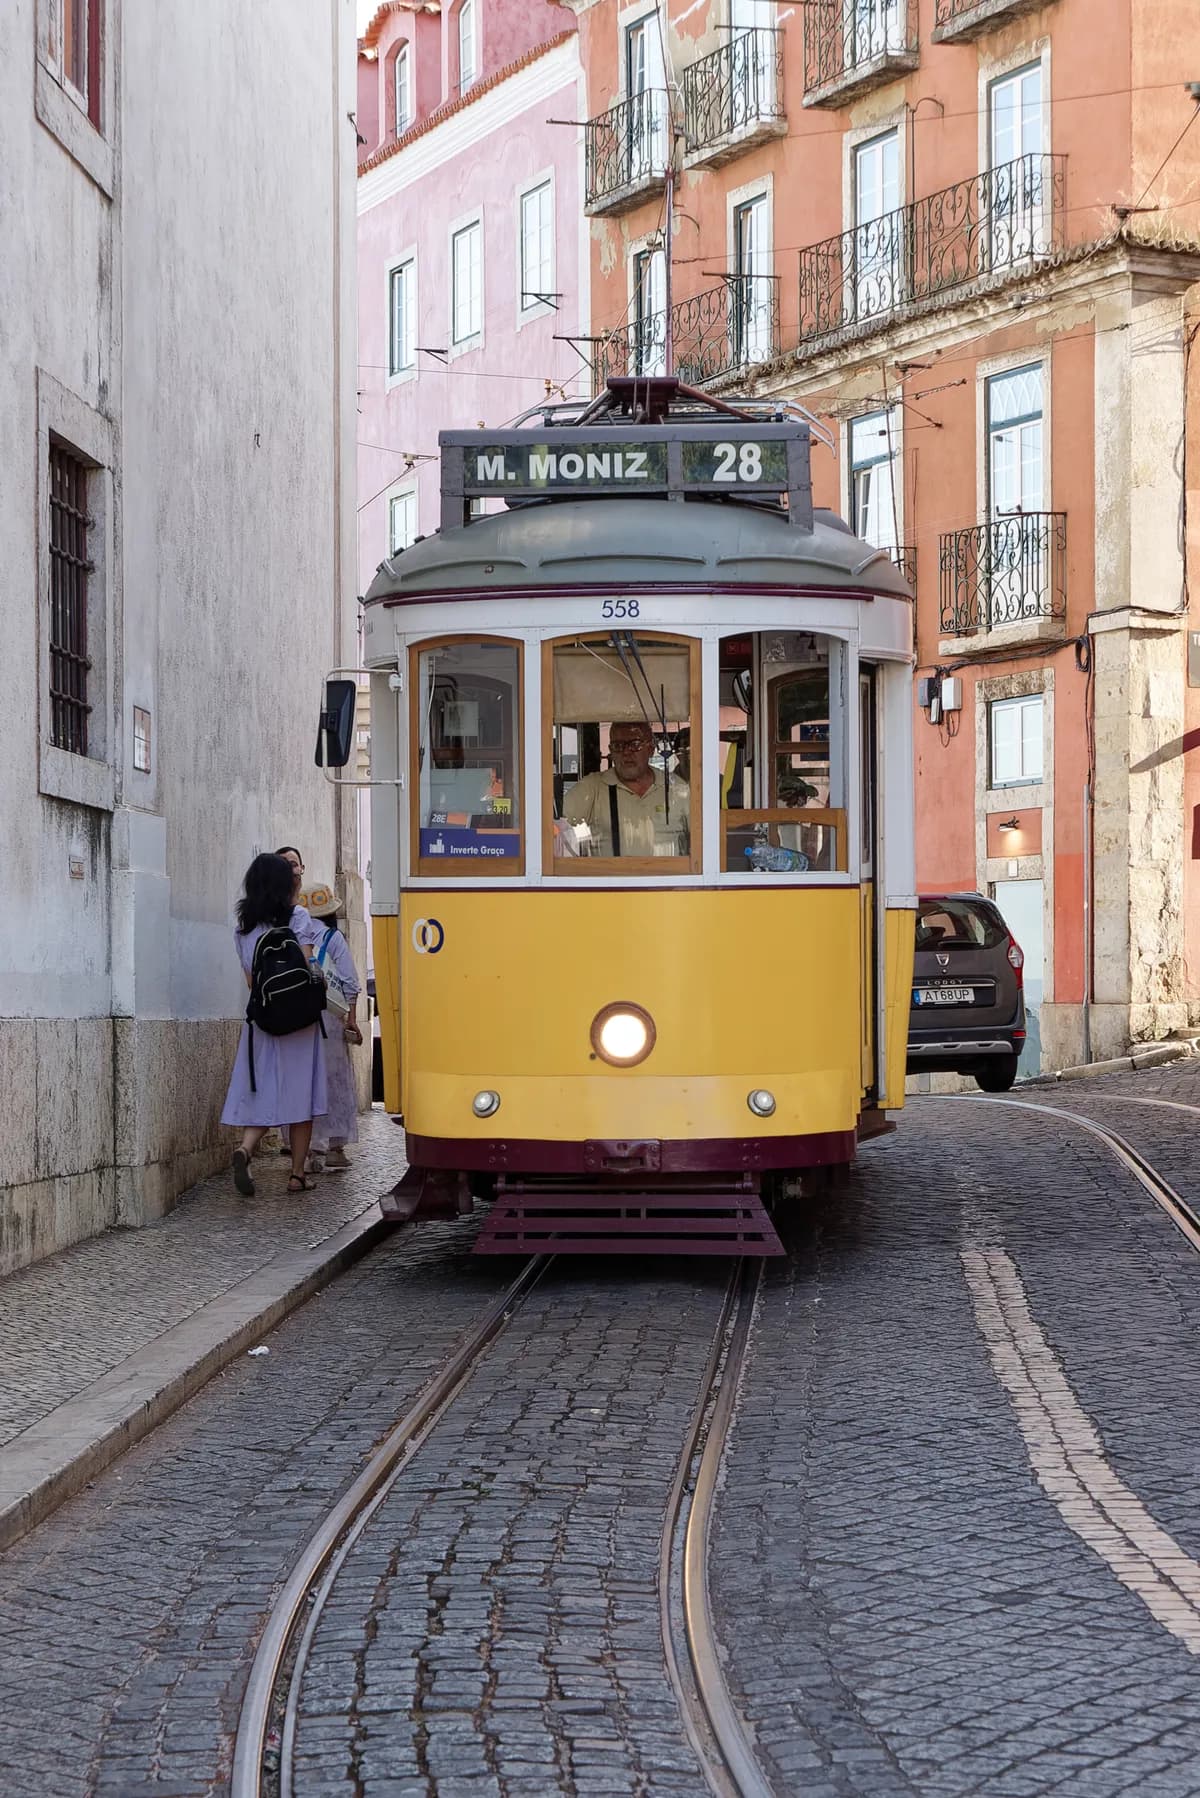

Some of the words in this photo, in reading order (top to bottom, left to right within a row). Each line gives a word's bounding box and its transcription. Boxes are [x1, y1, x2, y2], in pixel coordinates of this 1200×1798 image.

[476, 455, 516, 480] M.
[528, 452, 648, 479] MONIZ
[712, 443, 763, 481] 28
[602, 600, 640, 618] 558
[432, 814, 446, 823] 28E
[480, 845, 504, 857] Graça
